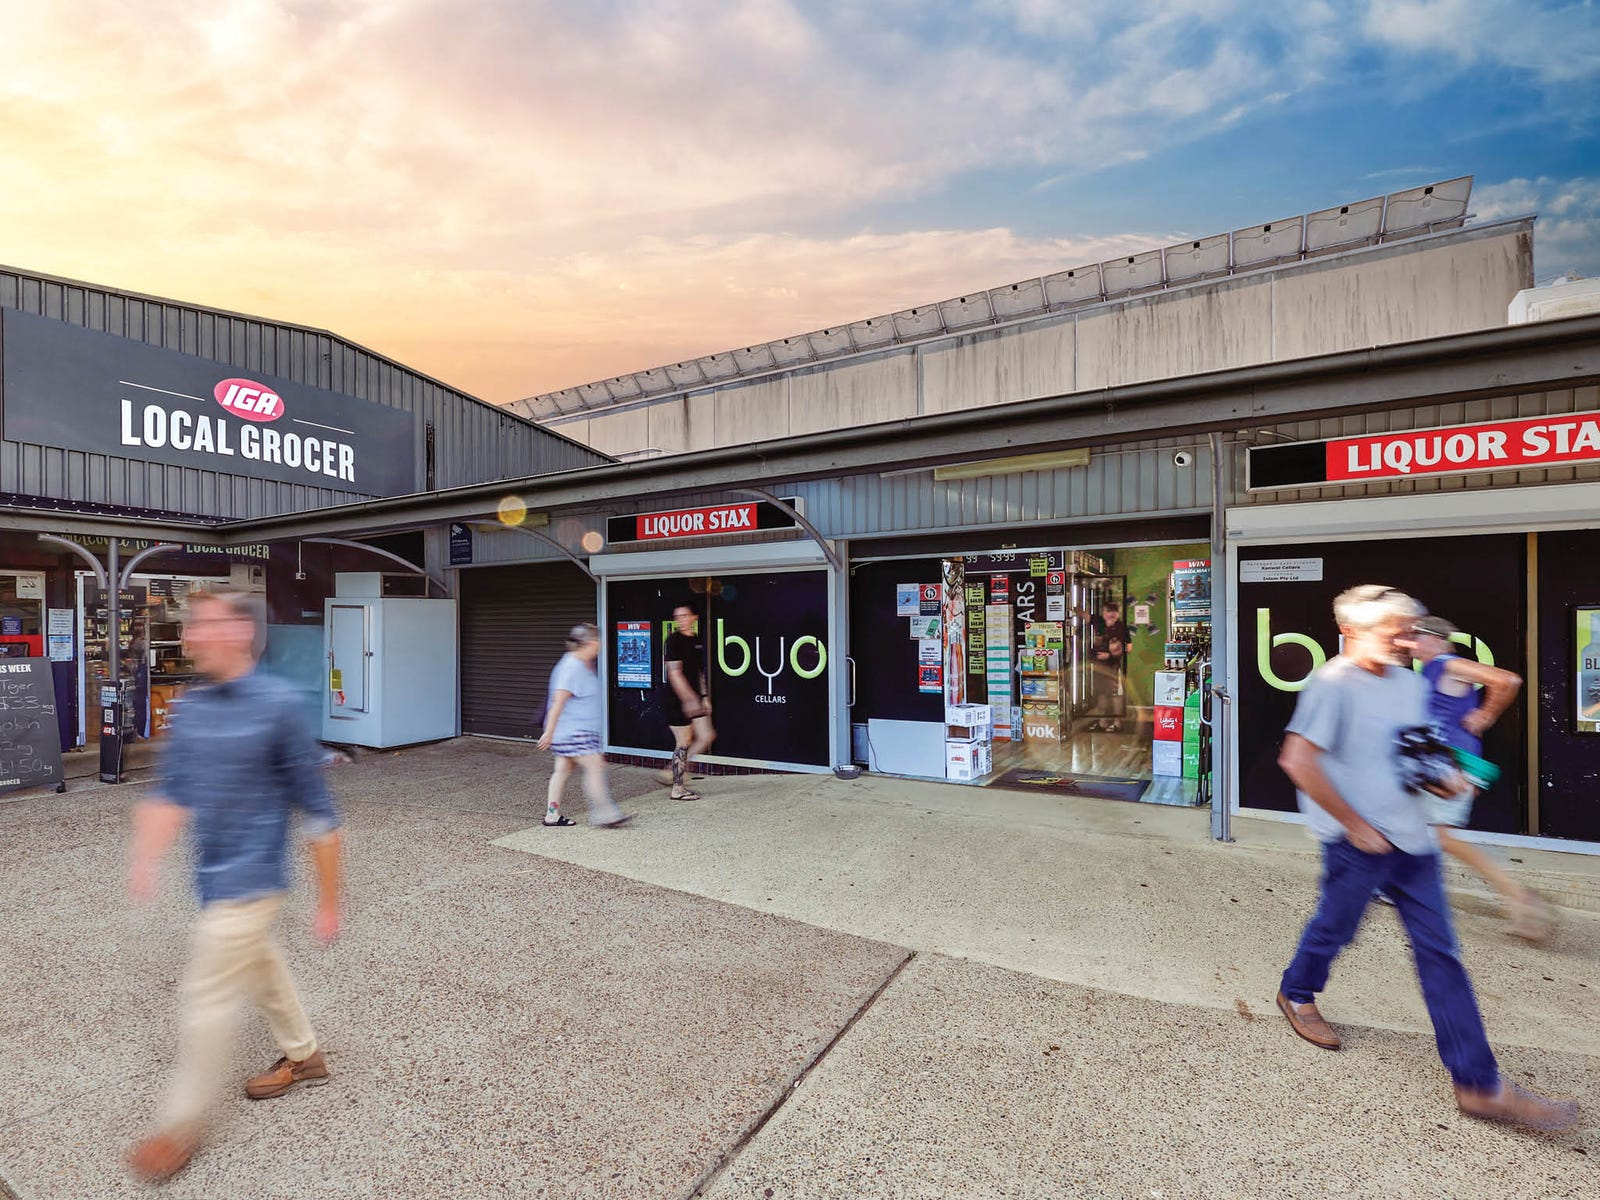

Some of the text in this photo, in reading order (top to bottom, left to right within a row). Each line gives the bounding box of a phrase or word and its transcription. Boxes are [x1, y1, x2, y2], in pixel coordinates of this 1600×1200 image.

[221, 383, 278, 417] IGA
[120, 399, 356, 483] LOCAL GROCER
[1347, 420, 1600, 473] LIQUOR STA
[643, 507, 751, 537] LIQUOR STAX
[8, 663, 32, 673] WEEK
[754, 694, 787, 704] CELLARS
